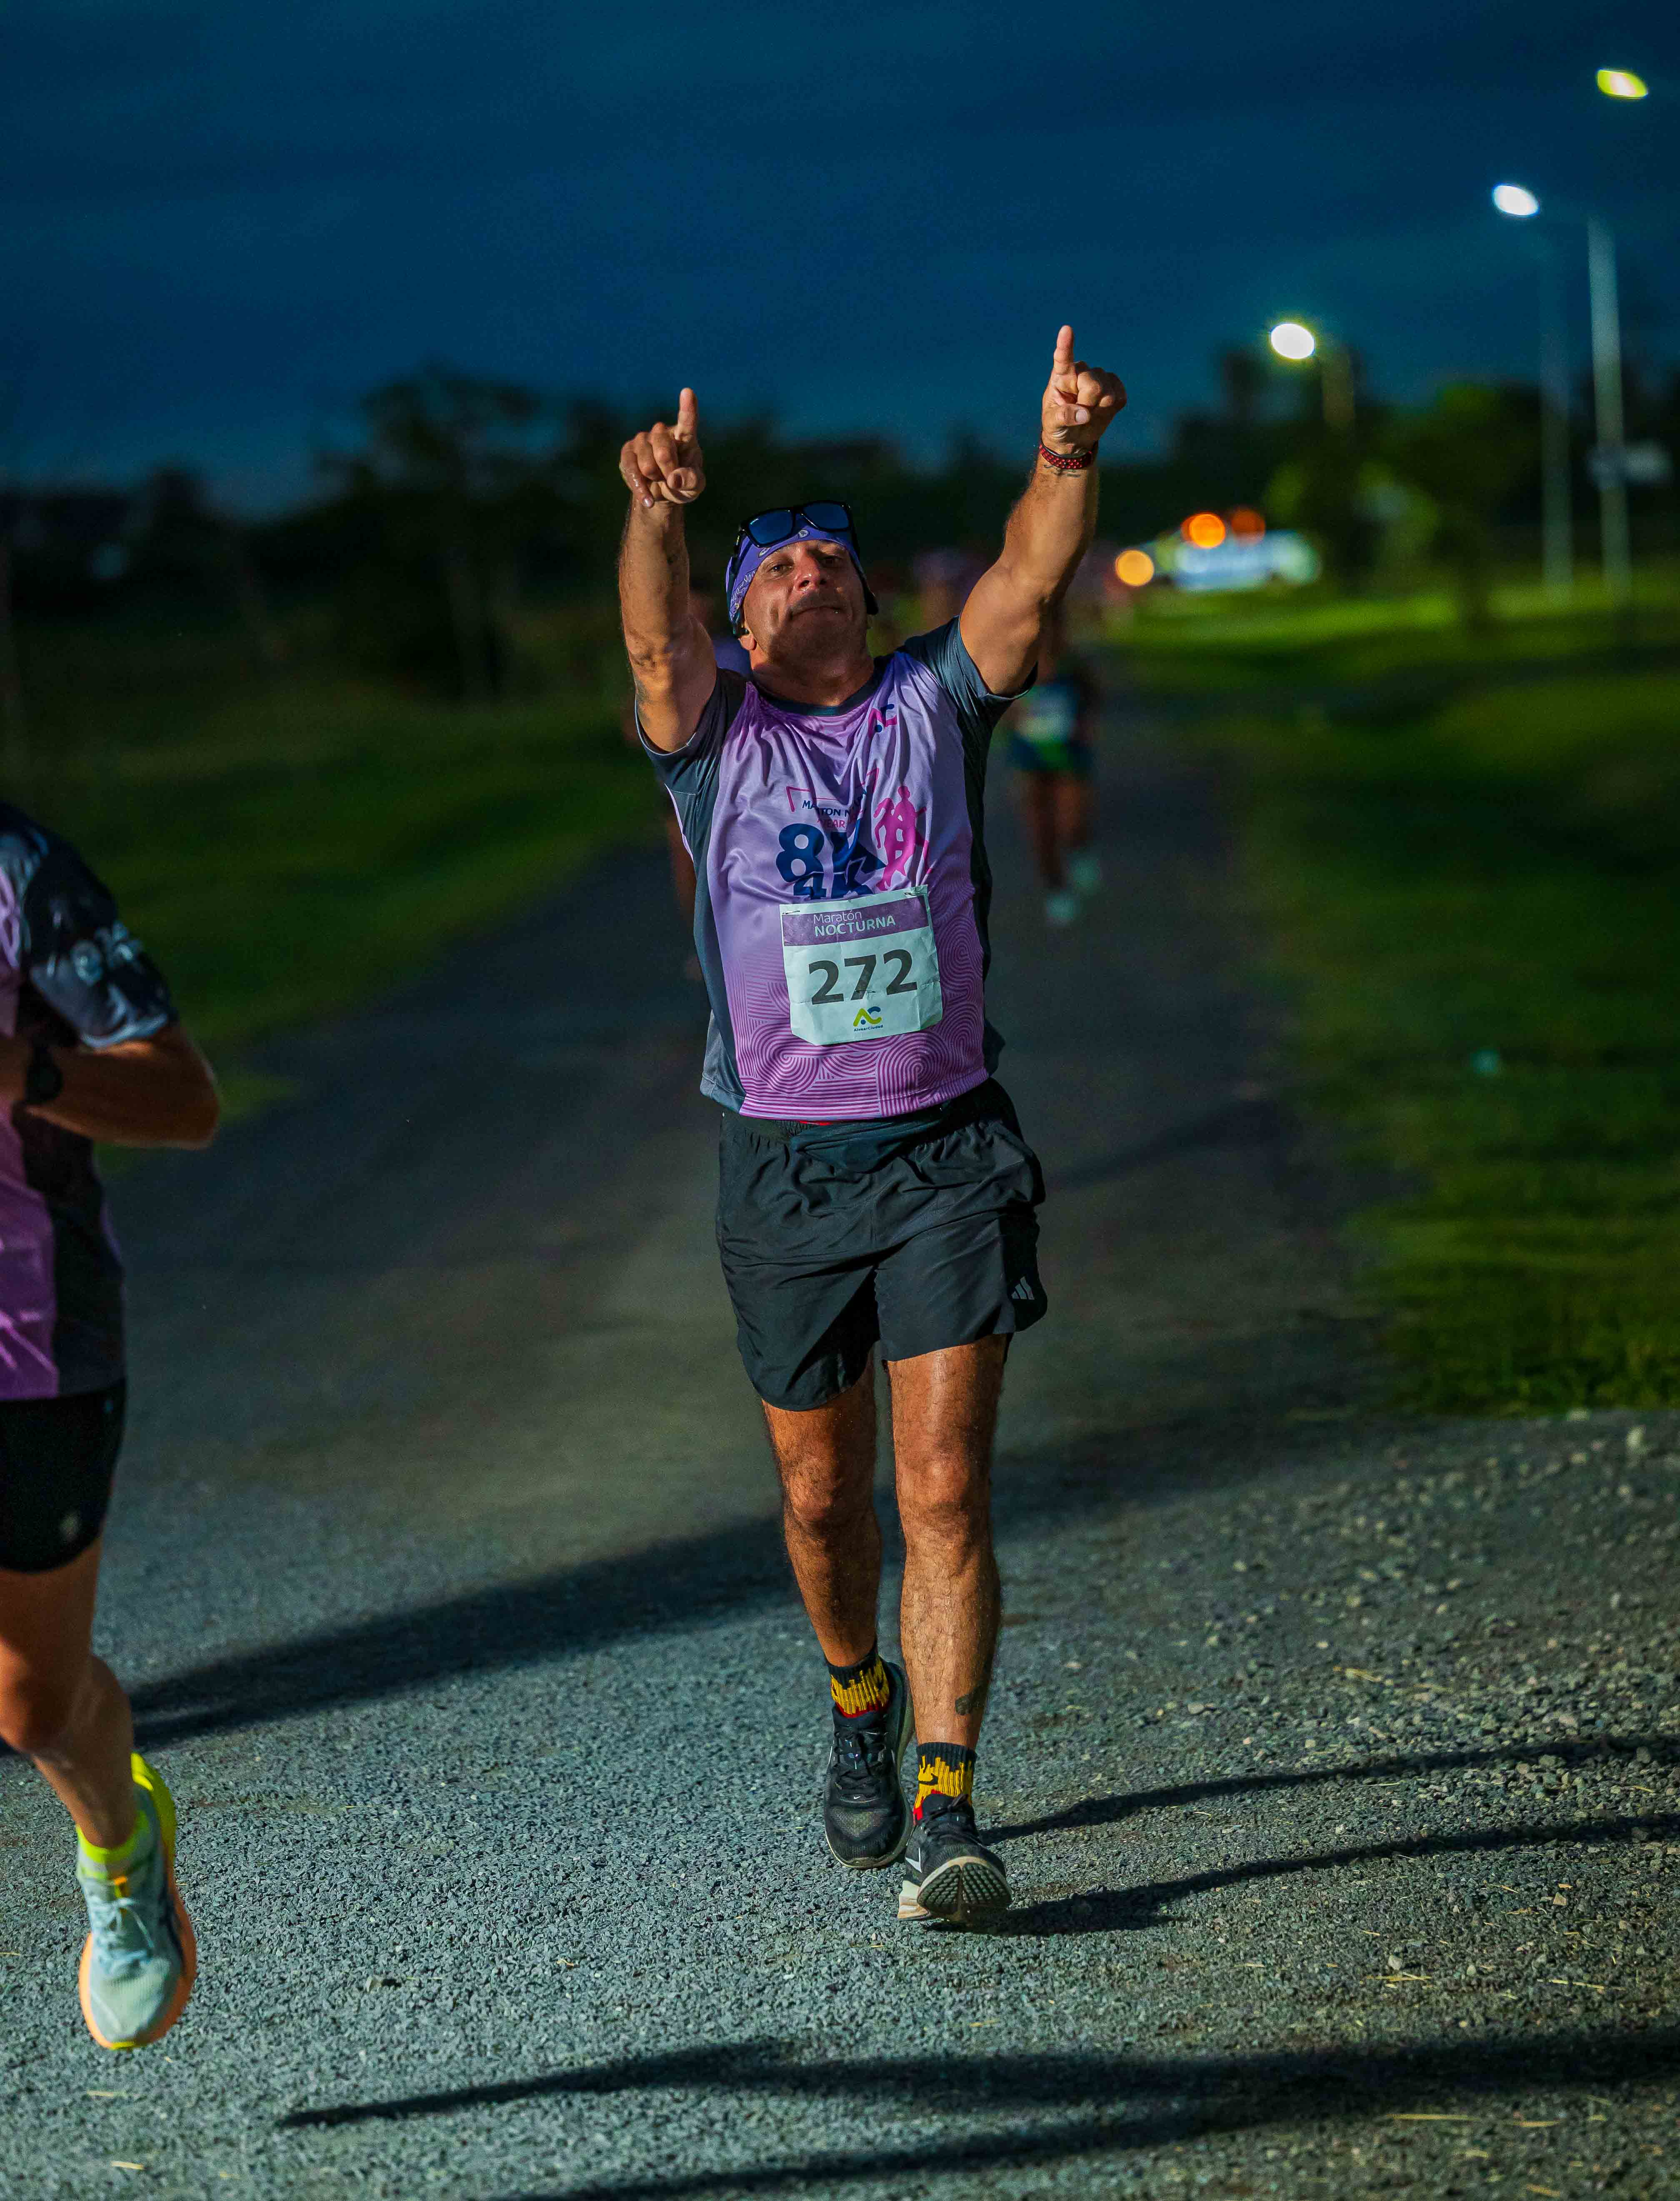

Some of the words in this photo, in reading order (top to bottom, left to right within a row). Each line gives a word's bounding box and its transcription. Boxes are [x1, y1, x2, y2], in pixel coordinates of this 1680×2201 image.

[813, 910, 862, 924] Maratón
[814, 915, 896, 937] NOCTURNA
[808, 949, 918, 1004] 272
